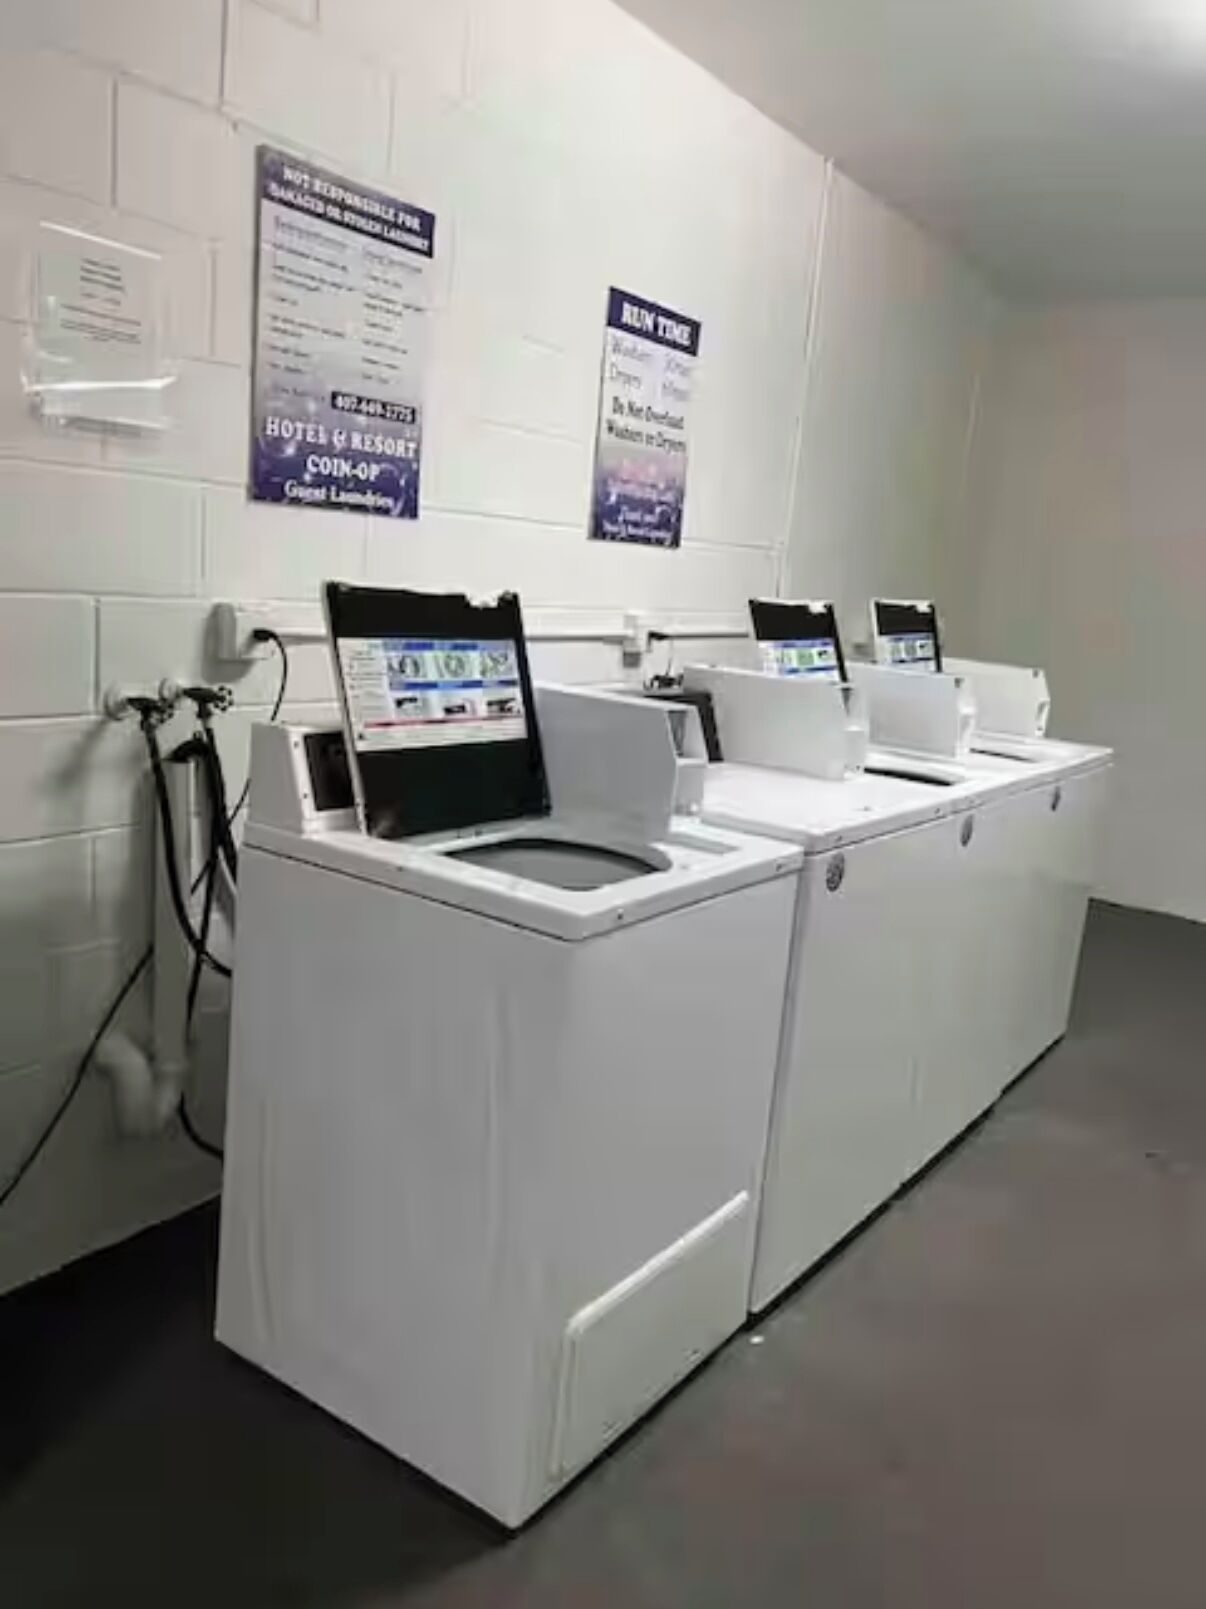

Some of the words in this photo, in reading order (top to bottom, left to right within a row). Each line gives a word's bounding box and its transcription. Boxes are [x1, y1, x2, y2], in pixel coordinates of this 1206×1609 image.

[282, 165, 310, 188] NOT
[313, 179, 396, 223] RESPONSIBLE
[398, 212, 423, 233] FOR
[621, 300, 657, 333] RUN
[657, 315, 692, 347] TIME
[605, 418, 644, 444] Washers
[613, 395, 625, 415] Do
[628, 400, 644, 420] Not
[645, 405, 685, 431] Overload
[264, 415, 328, 446] HOTEL
[351, 430, 419, 459] RESORT
[305, 453, 382, 482] COIN-OP
[283, 479, 327, 502] Guest
